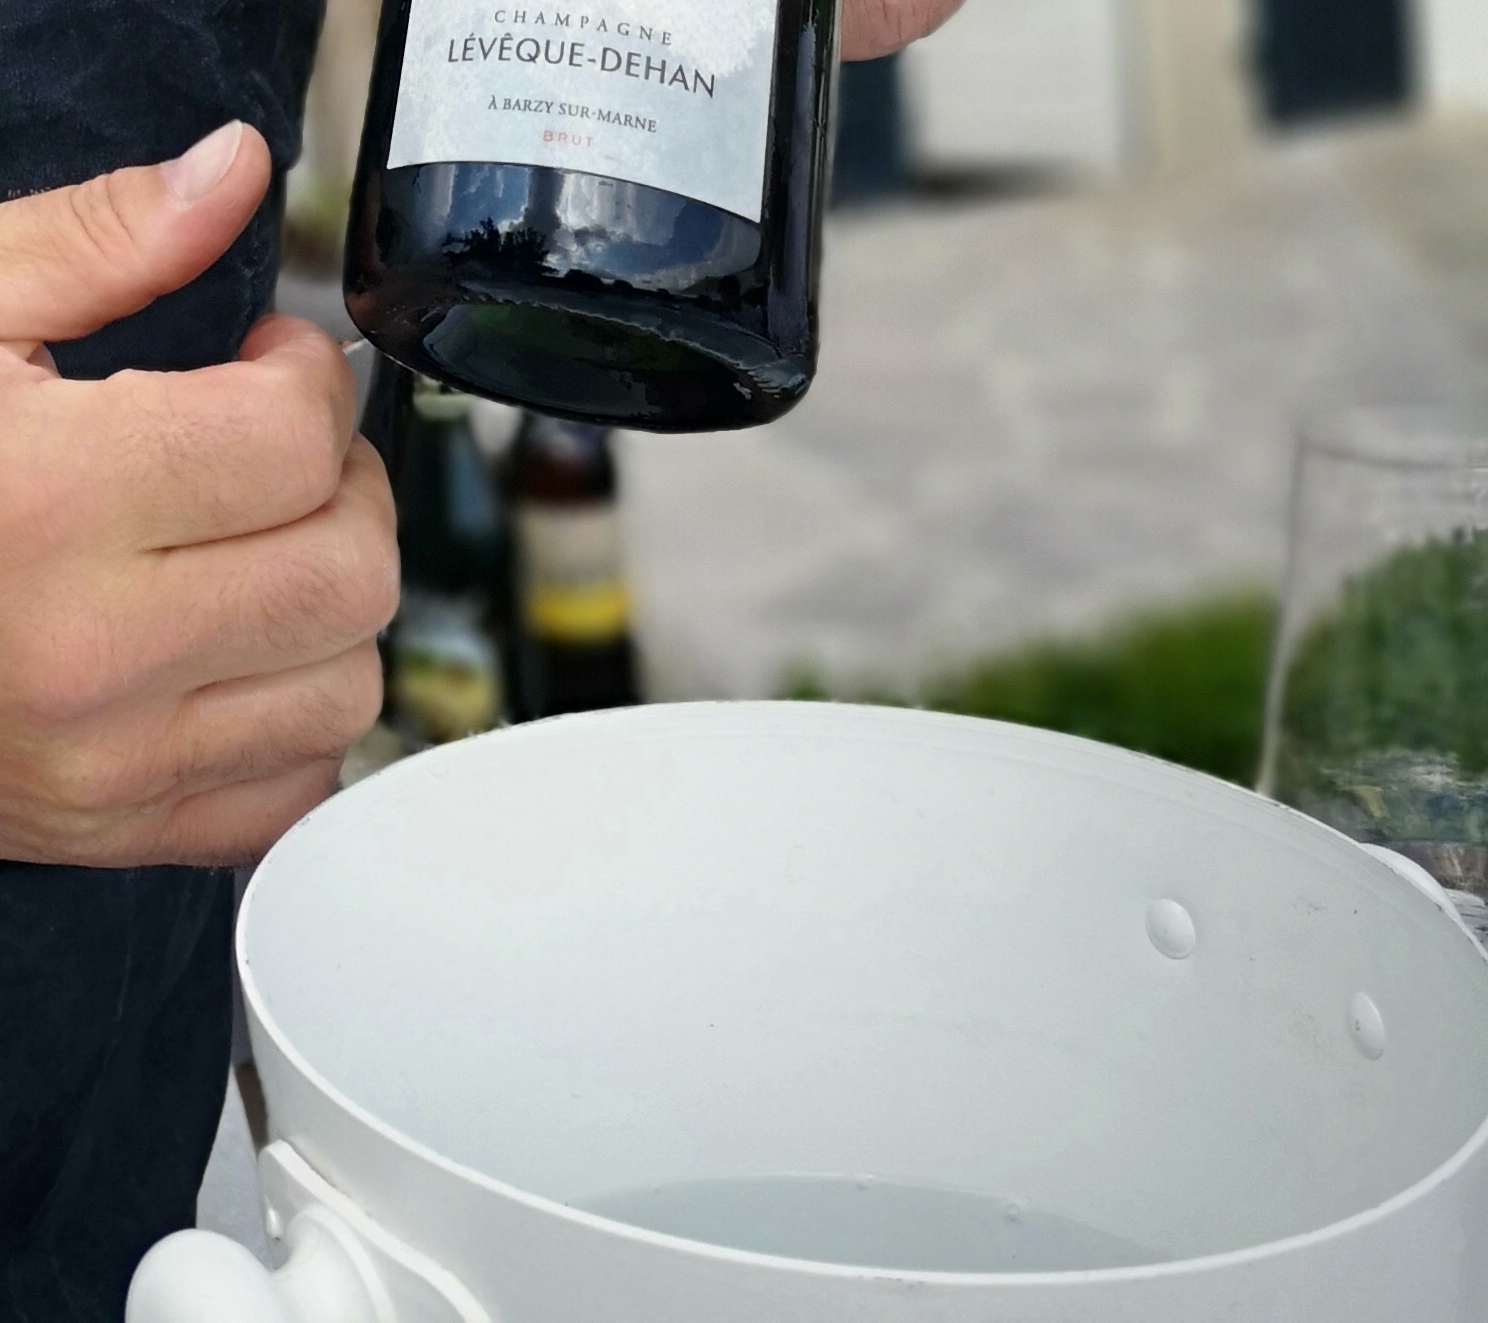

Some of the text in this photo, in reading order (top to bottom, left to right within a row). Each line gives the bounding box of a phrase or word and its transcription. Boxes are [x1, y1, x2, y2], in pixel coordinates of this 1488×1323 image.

[494, 9, 673, 46] CHAMPAGNE
[447, 31, 716, 99] LÉVÊQUE-DEHAN
[502, 97, 555, 114] BARZY
[558, 102, 658, 133] SUR-MARNE
[542, 129, 594, 147] BRUT
